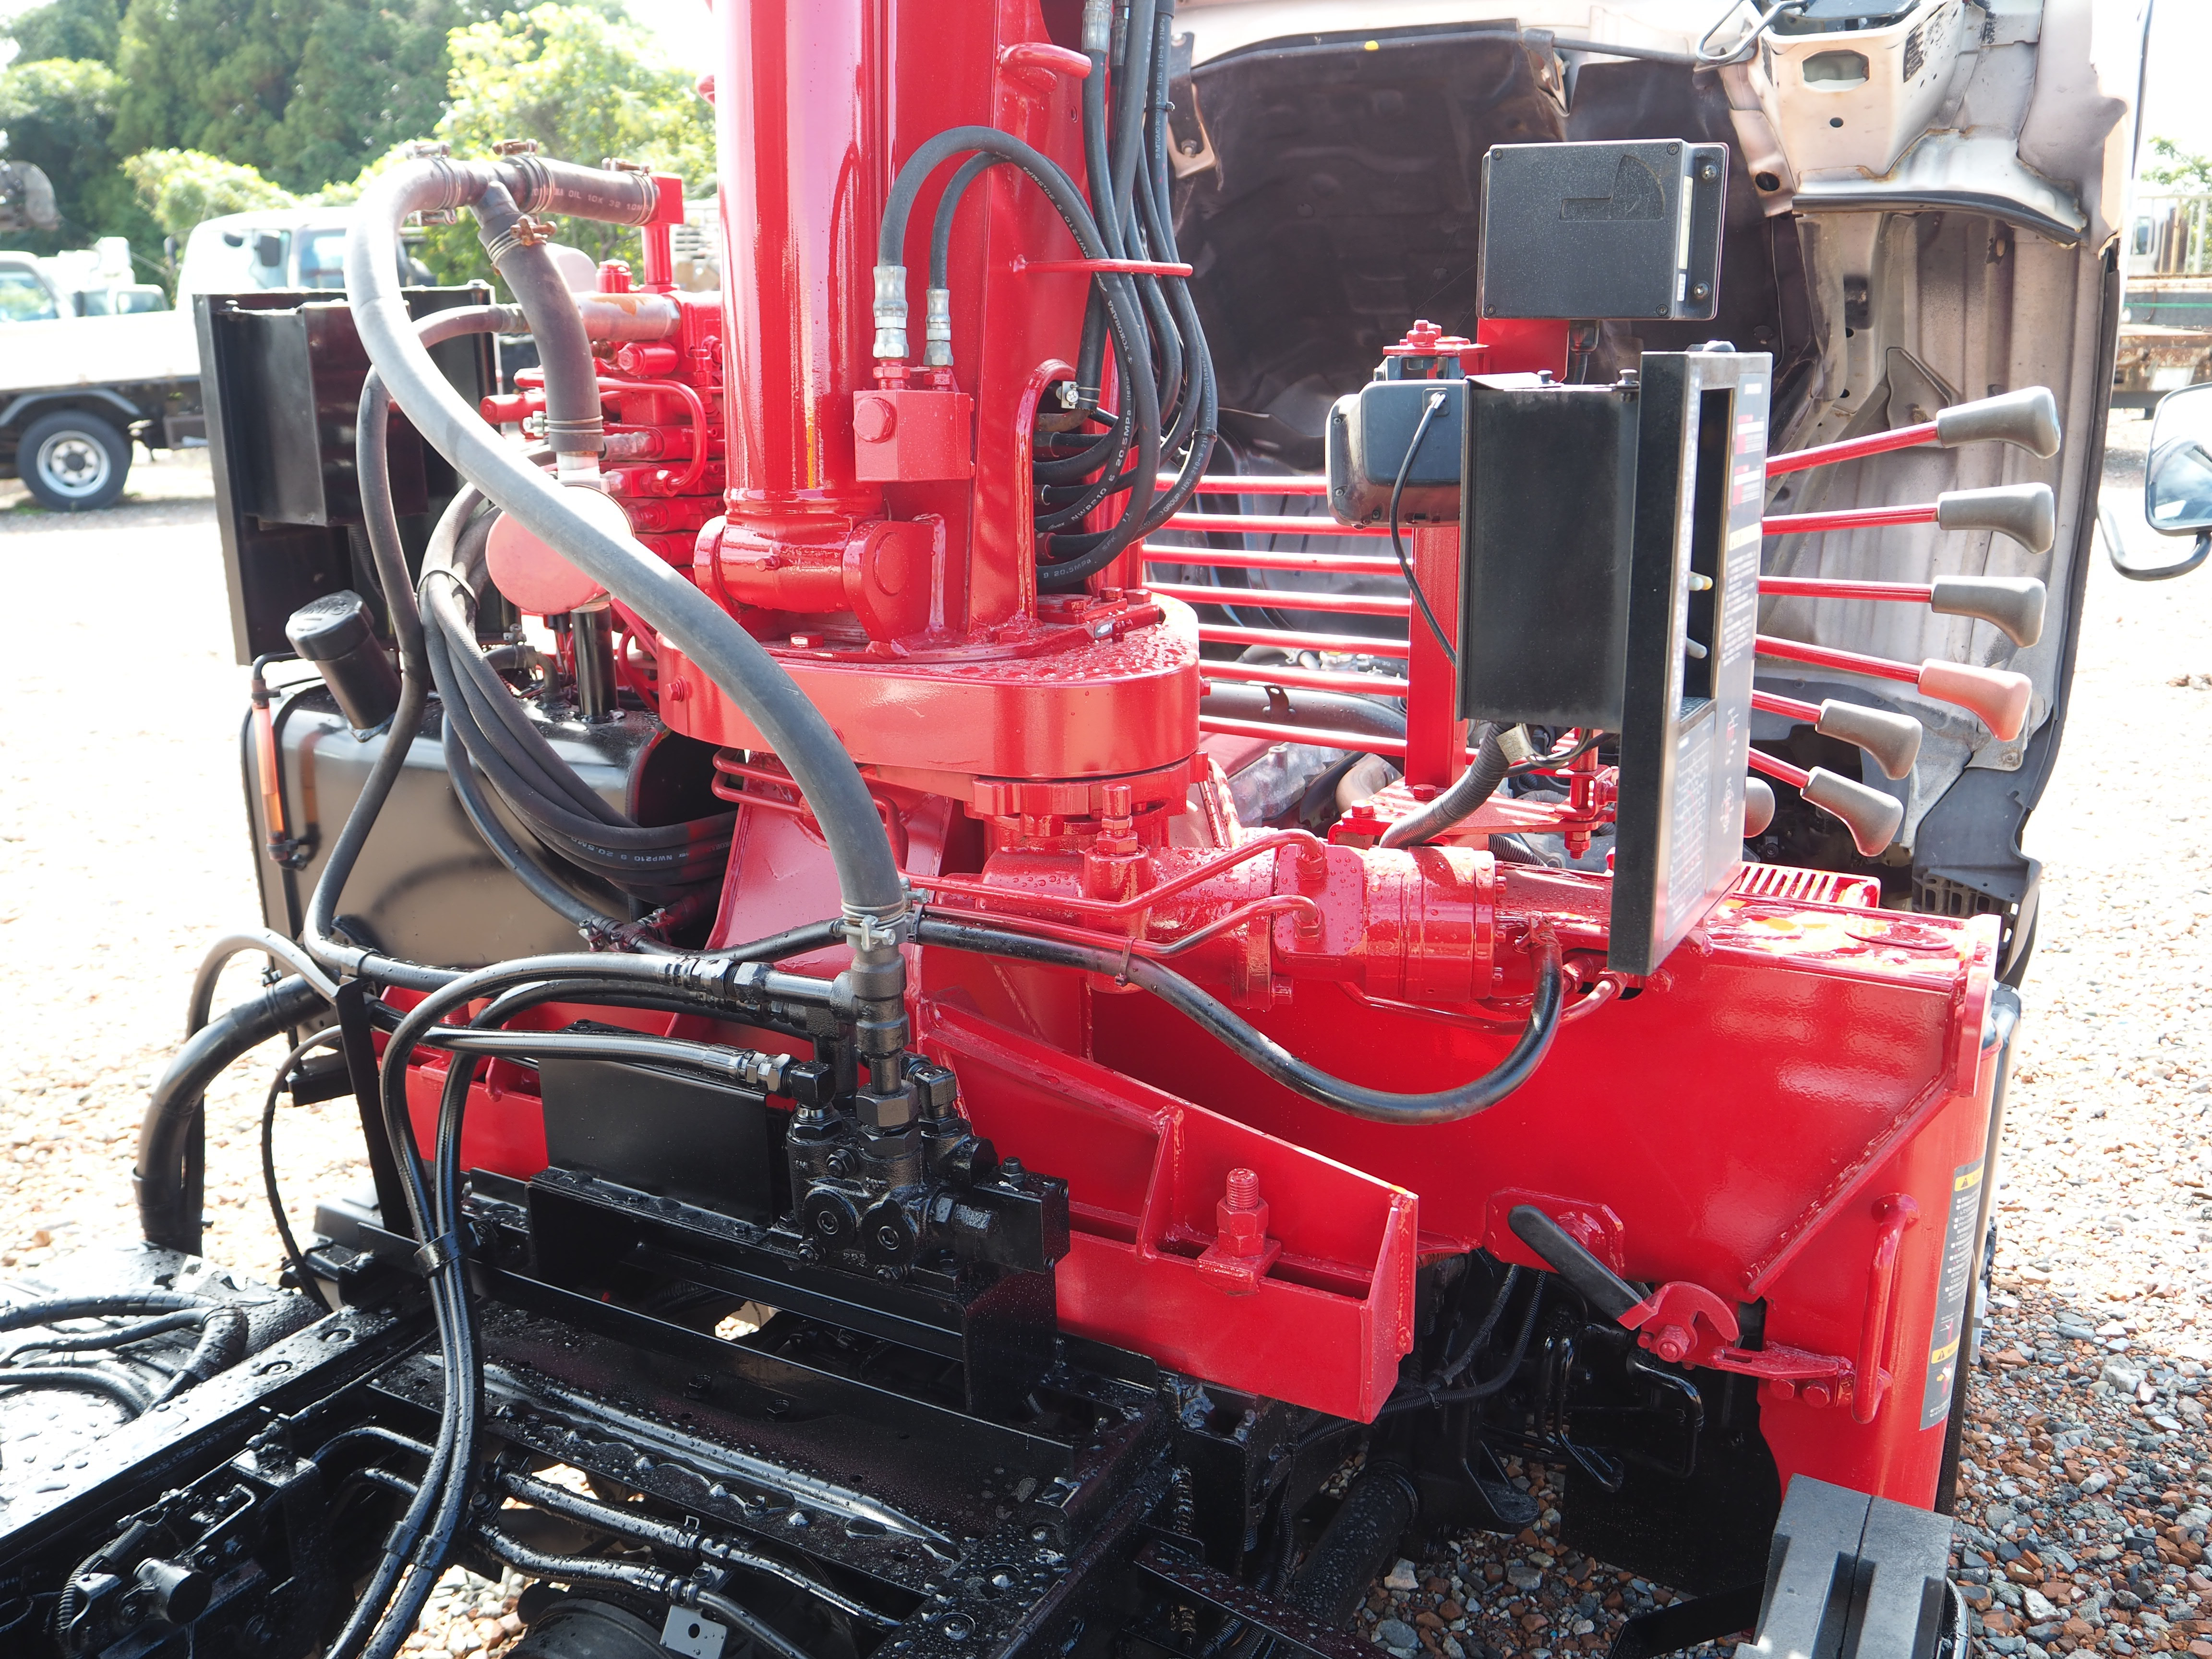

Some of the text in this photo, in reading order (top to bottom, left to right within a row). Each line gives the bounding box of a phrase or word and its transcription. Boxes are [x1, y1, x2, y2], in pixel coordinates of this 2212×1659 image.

[568, 190, 581, 199] OIL
[587, 194, 603, 204] 10K
[608, 200, 621, 208] 32
[1022, 167, 1055, 200] 20.5MPa
[1064, 216, 1090, 259] NWP210
[1107, 300, 1129, 352] YOKOHAMA
[1070, 488, 1107, 521] NWP210
[1116, 409, 1131, 467] 20.5MPa
[1163, 493, 1180, 512] GROUP
[1191, 453, 1204, 475] 210-9
[1054, 559, 1092, 577] 20.5MPa
